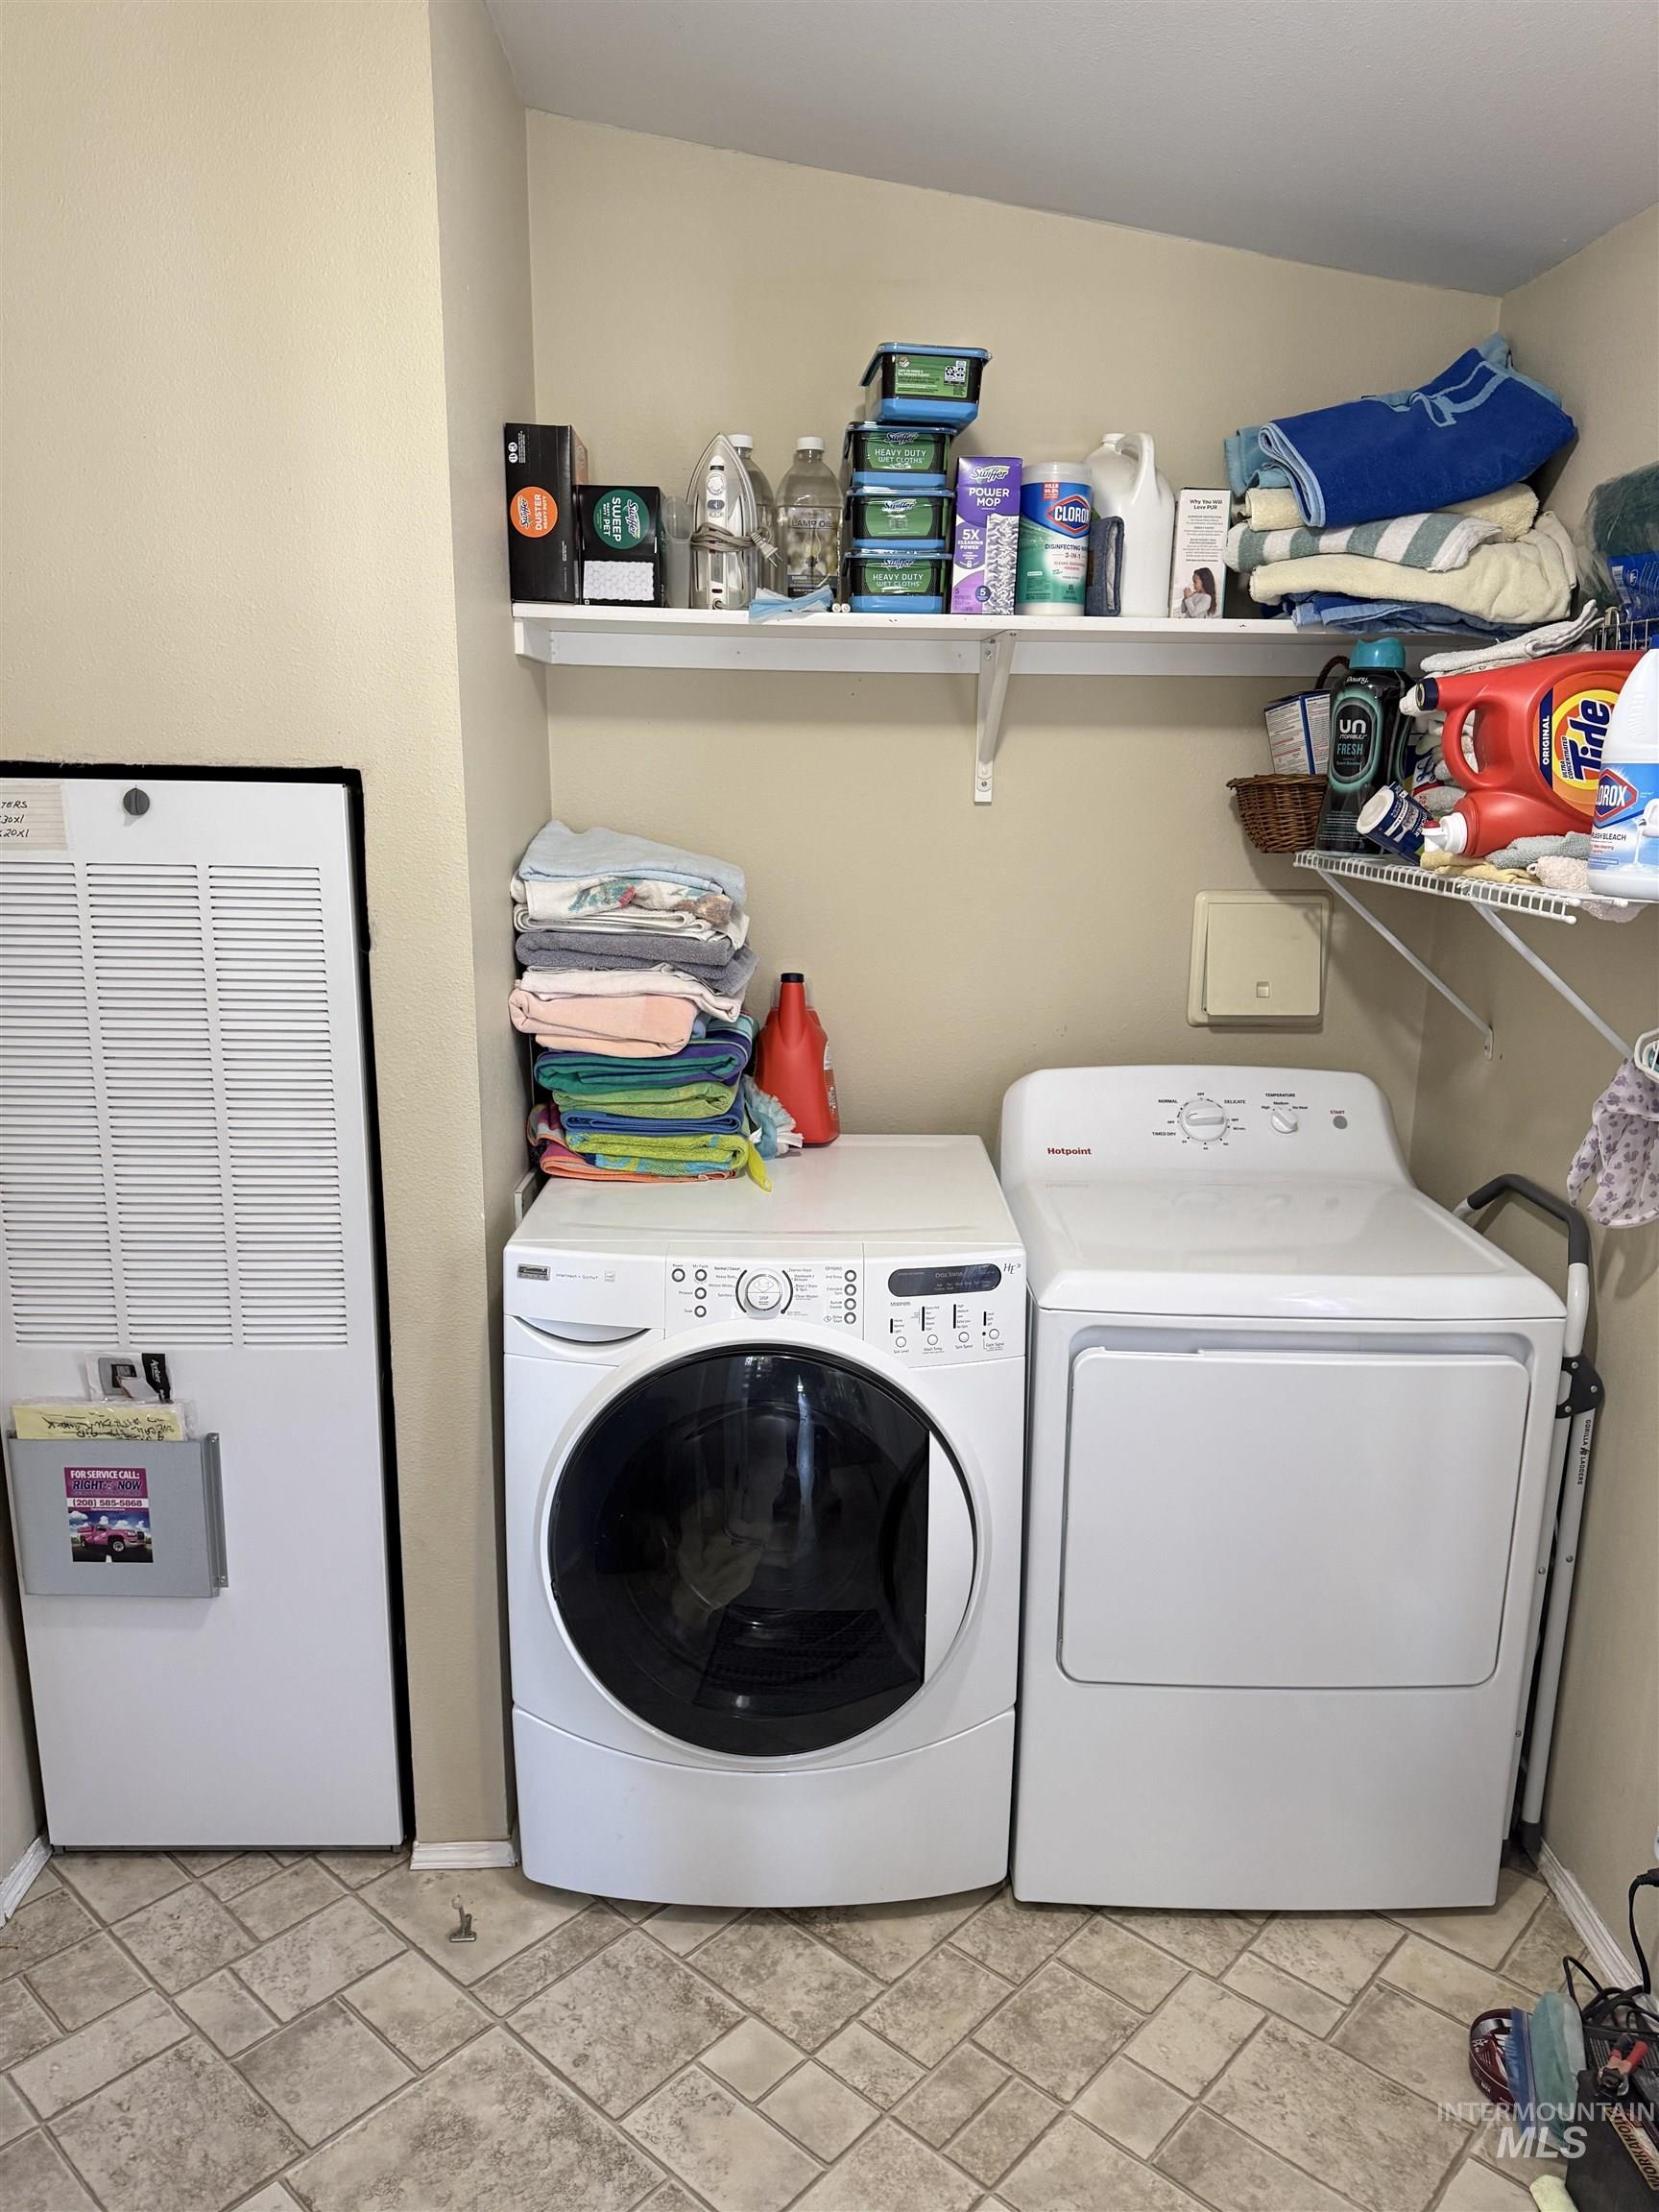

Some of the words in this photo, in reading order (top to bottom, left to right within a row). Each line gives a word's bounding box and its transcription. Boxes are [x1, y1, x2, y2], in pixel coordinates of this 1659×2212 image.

[884, 432, 919, 445] Swiffer
[970, 466, 1010, 482] Swiffer
[969, 488, 1010, 497] POWER
[882, 499, 917, 510] Swiffer
[977, 498, 1000, 506] MOP
[517, 494, 531, 529] Swiffer
[612, 497, 622, 541] SWEEP
[625, 499, 640, 538] Swiffer
[962, 529, 980, 540] 5X
[881, 558, 914, 569] Swiffer
[1346, 676, 1369, 684] Downy
[1568, 698, 1611, 781] Tide
[1337, 743, 1364, 756] FRESH
[1562, 736, 1574, 779] CONCENTRATED
[1047, 1147, 1092, 1156] Hotpoint
[1583, 1419, 1591, 1445] GORILLA
[71, 1470, 86, 1479] FOR
[87, 1470, 118, 1479] SERVICE
[1577, 1457, 1587, 1485] LADDERS
[73, 1480, 103, 1490] RIGHT
[118, 1481, 141, 1490] NOW
